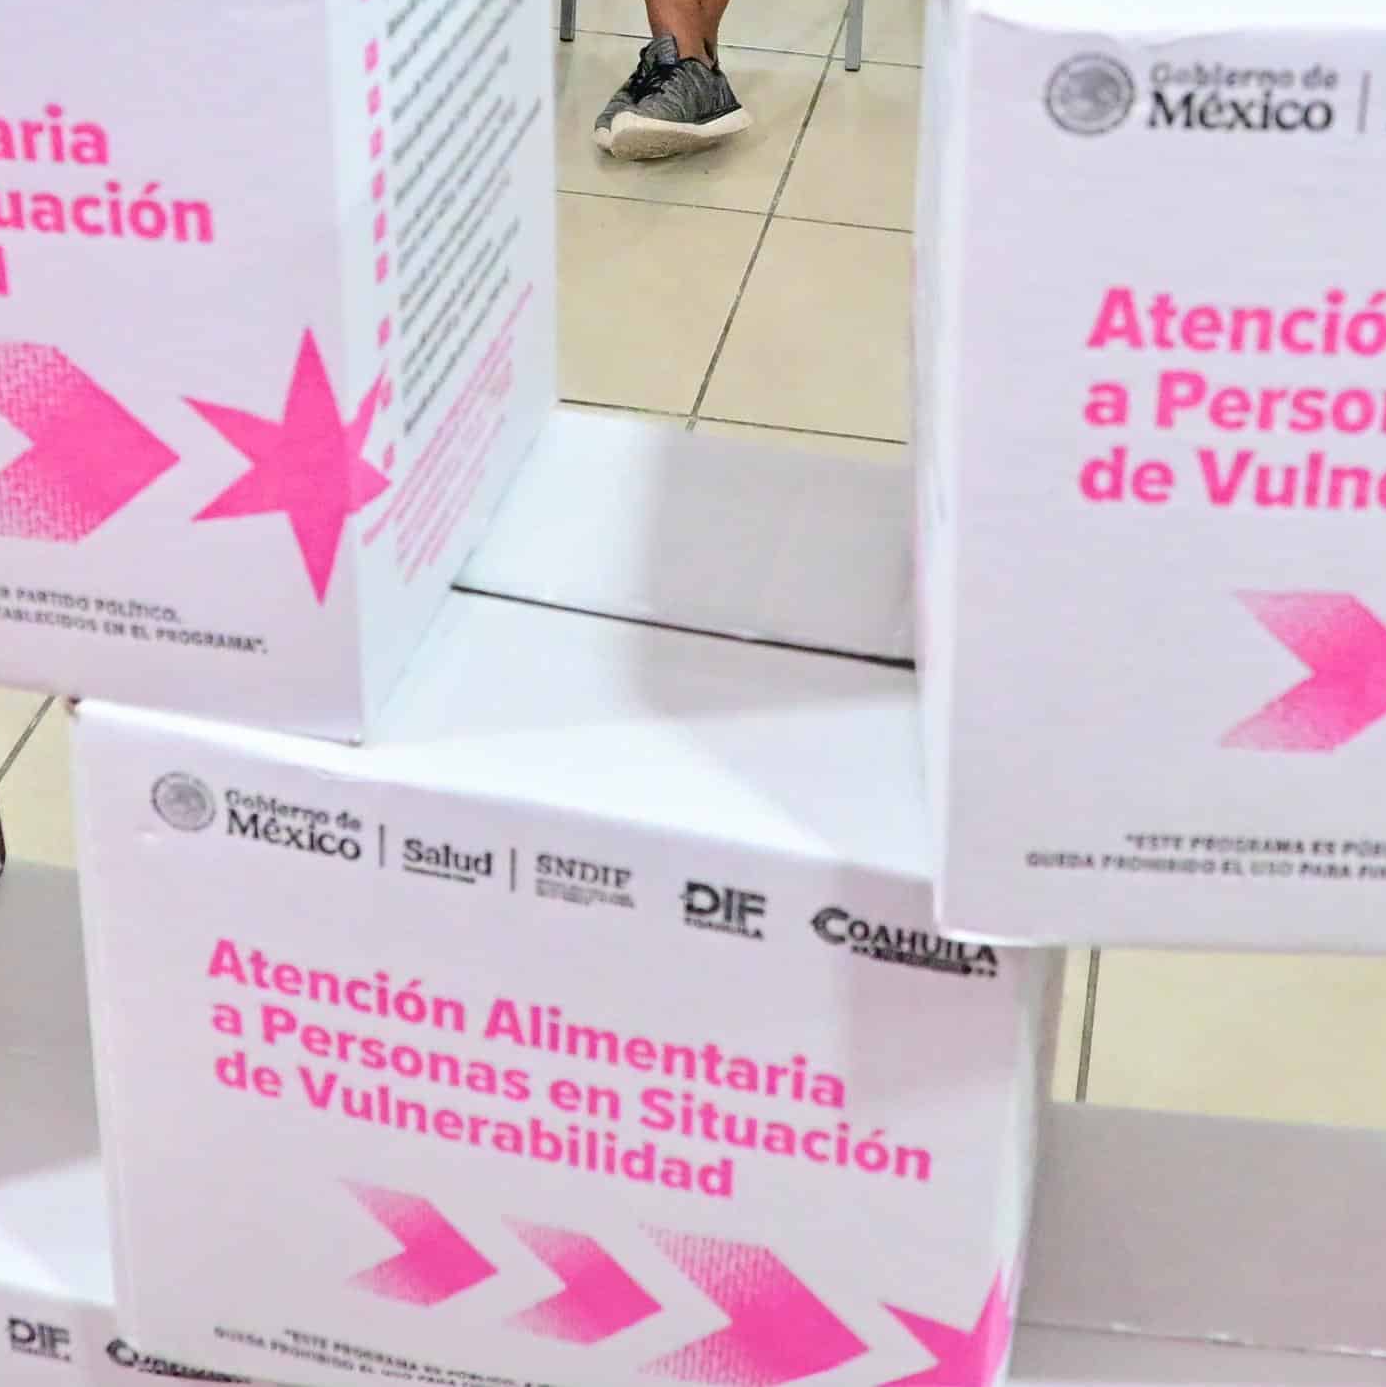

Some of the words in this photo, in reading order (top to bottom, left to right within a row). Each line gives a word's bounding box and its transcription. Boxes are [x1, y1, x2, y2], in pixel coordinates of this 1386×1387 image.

[1148, 62, 1297, 87] Gobierno
[1302, 65, 1338, 90] de
[1145, 89, 1333, 132] México
[1083, 381, 1130, 427] a
[1078, 445, 1175, 504] de
[16, 587, 89, 611] PARTIDO
[104, 620, 126, 637] EN
[131, 624, 150, 641] EL
[223, 788, 330, 825] Gobierno
[335, 808, 363, 833] de
[226, 808, 362, 862] México
[402, 837, 493, 877] Salud
[536, 854, 632, 891] SNDIF
[683, 881, 766, 927] DIF
[811, 906, 998, 966] COAHUILA
[208, 938, 466, 1033] Atención
[484, 998, 846, 1109] Alimentaria
[212, 1004, 245, 1037] a
[261, 1004, 532, 1103] Personas
[549, 1078, 622, 1122] en
[639, 1087, 932, 1181] Situación
[215, 1050, 283, 1099] de
[298, 1066, 735, 1199] Vulnerabilidad
[7, 1317, 71, 1357] DIF
